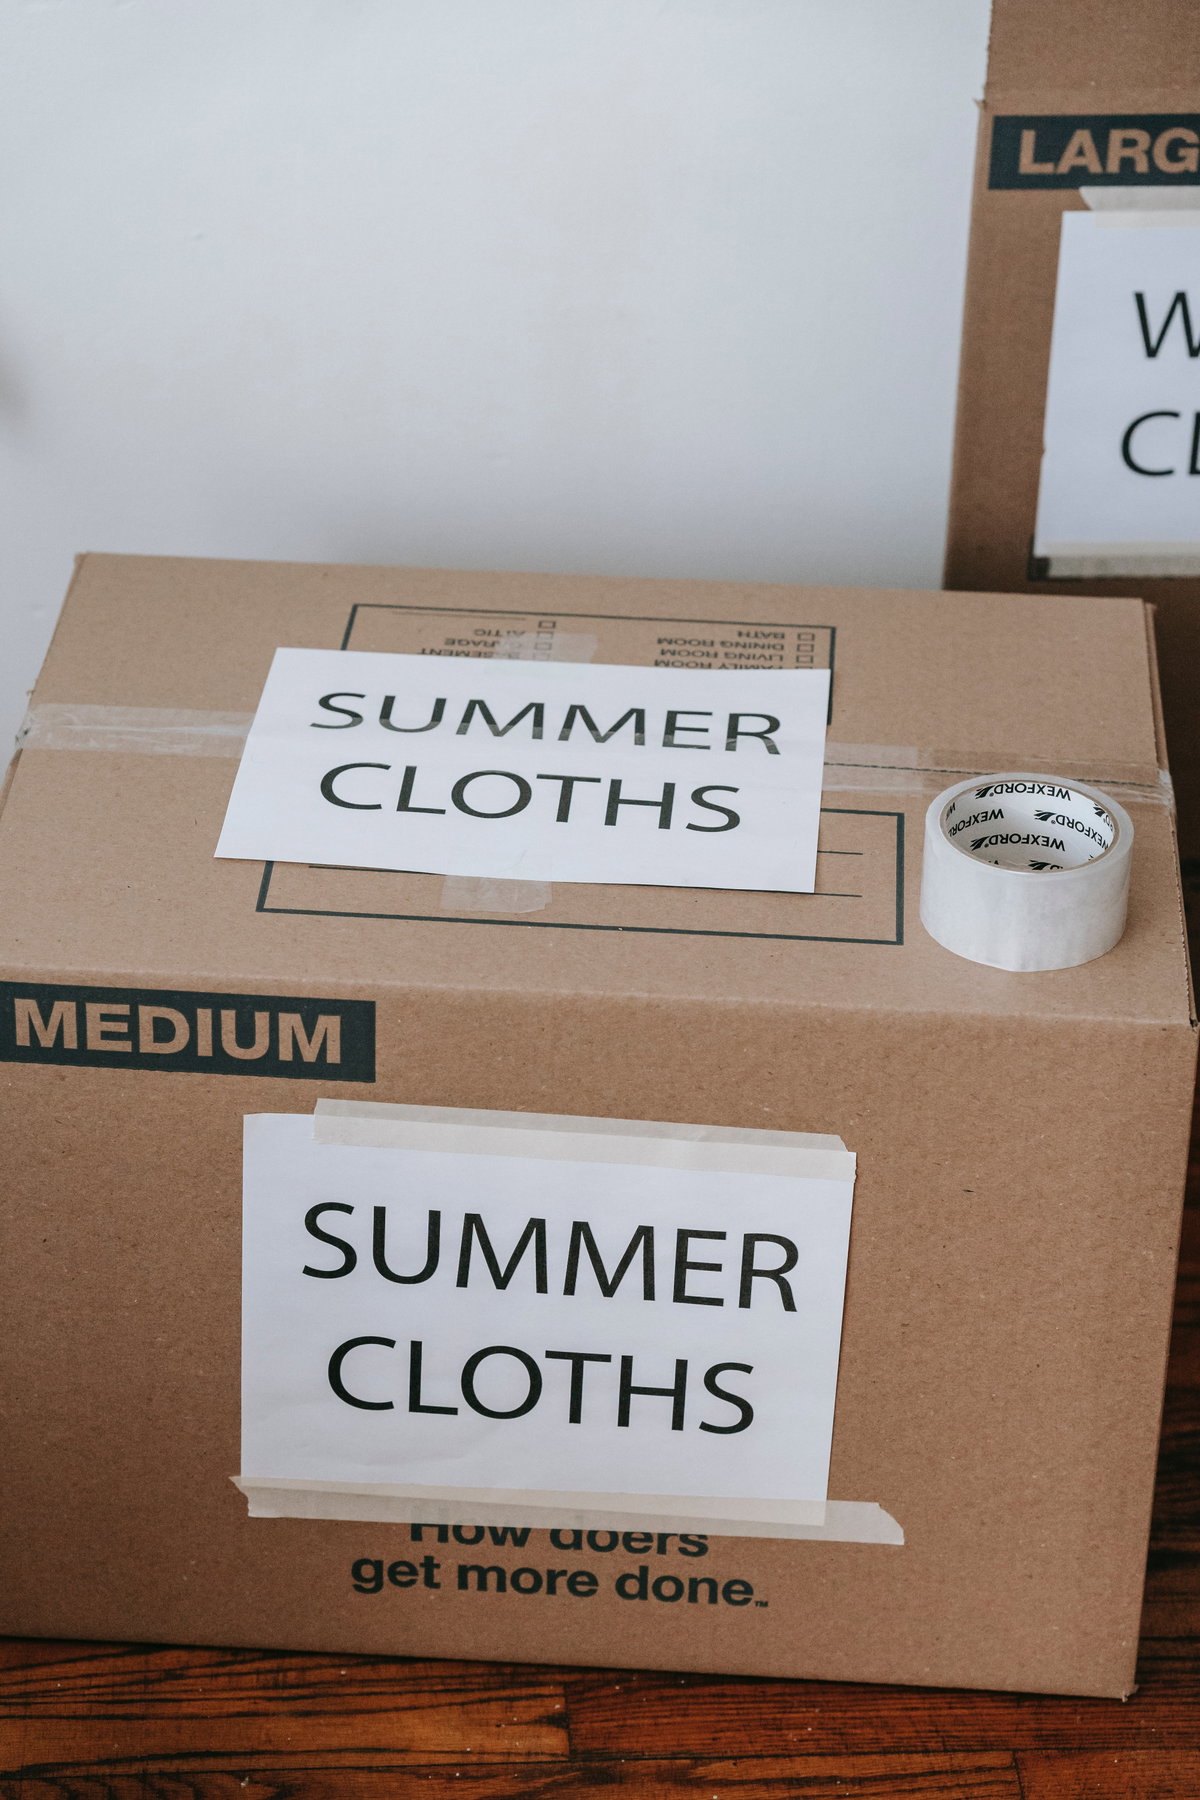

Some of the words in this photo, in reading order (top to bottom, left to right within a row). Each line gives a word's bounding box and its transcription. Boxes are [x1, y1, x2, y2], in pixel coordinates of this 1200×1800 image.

[657, 637, 714, 647] ROOM
[720, 639, 784, 651] DINING
[737, 630, 785, 639] BATH
[654, 659, 712, 669] ROOM
[660, 648, 718, 658] ROOM
[724, 651, 784, 662] LIVING
[311, 693, 780, 755] SUMMER
[321, 763, 740, 832] CLOTHS
[14, 998, 342, 1064] MEDIUM
[302, 1202, 799, 1312] SUMMER
[327, 1336, 754, 1435] CLOTHS
[351, 1555, 441, 1595] get
[457, 1562, 599, 1598] more
